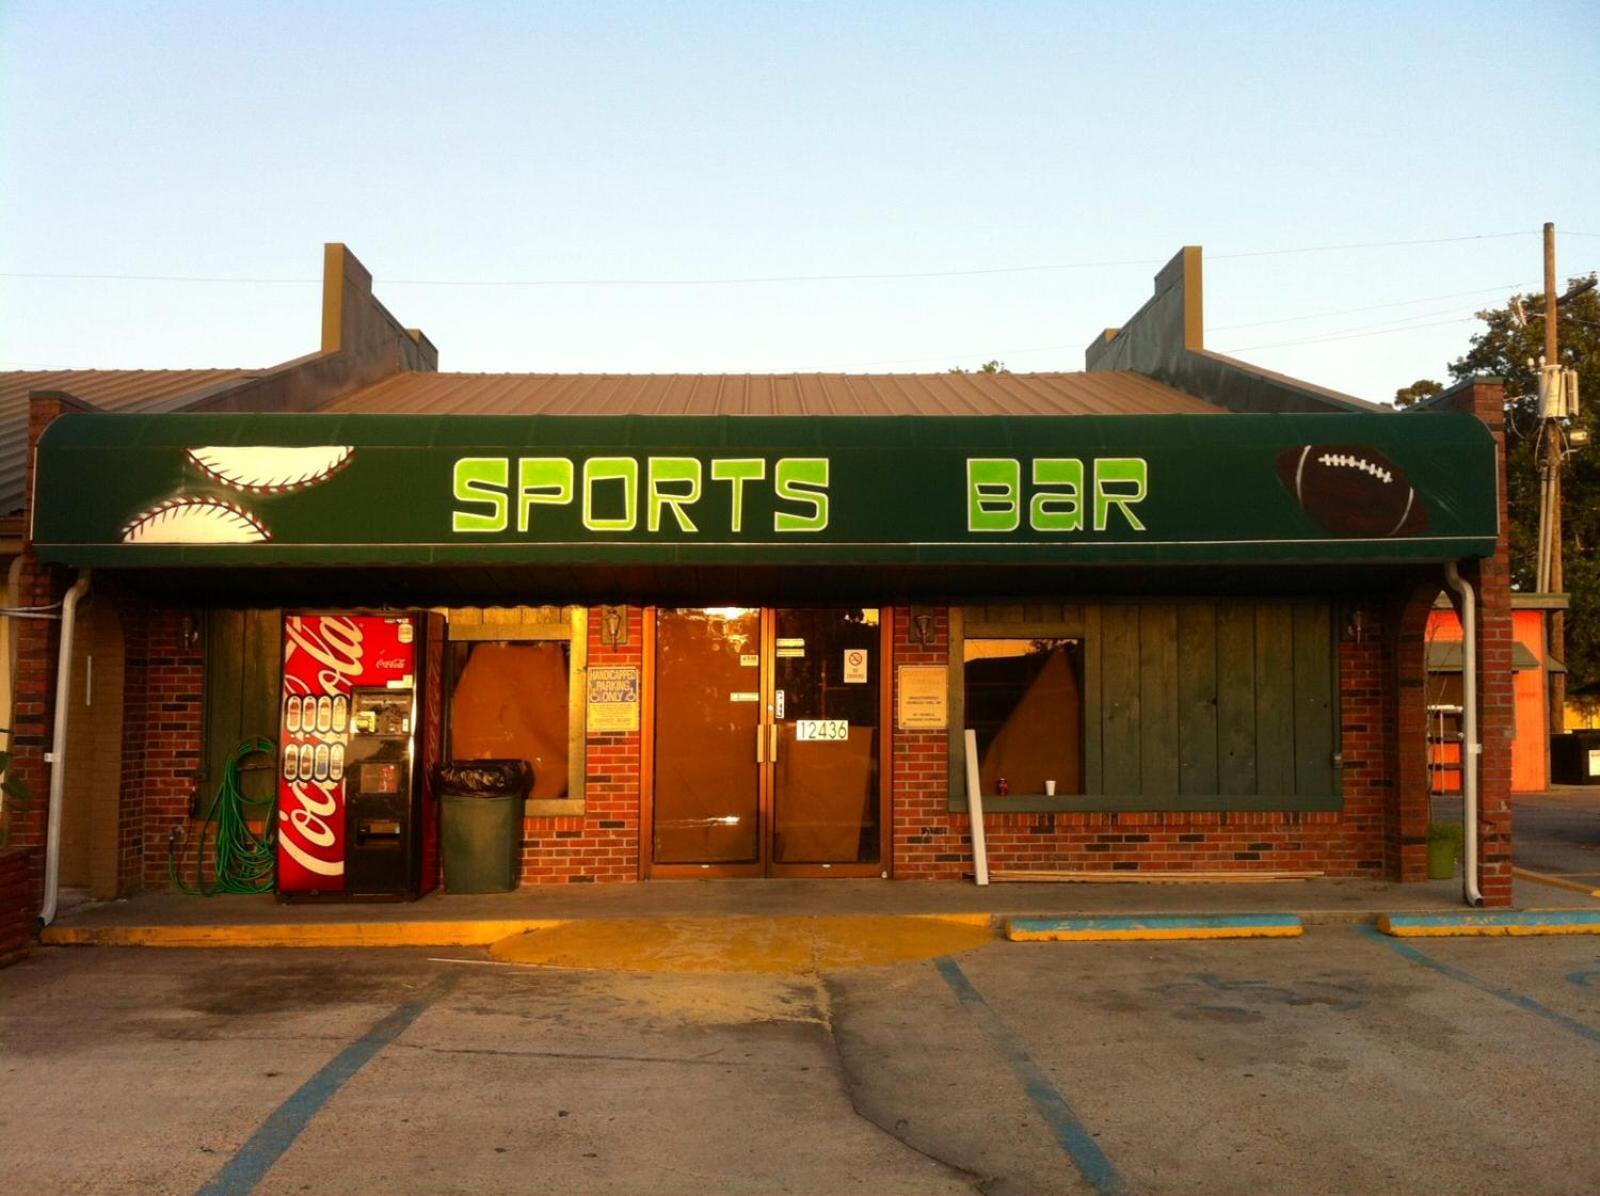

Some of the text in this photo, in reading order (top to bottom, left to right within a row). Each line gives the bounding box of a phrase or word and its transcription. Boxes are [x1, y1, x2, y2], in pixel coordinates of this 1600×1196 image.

[452, 456, 830, 534] SPORTS
[597, 681, 630, 691] PARKING
[602, 690, 623, 702] ONLY
[799, 721, 847, 740] 12436
